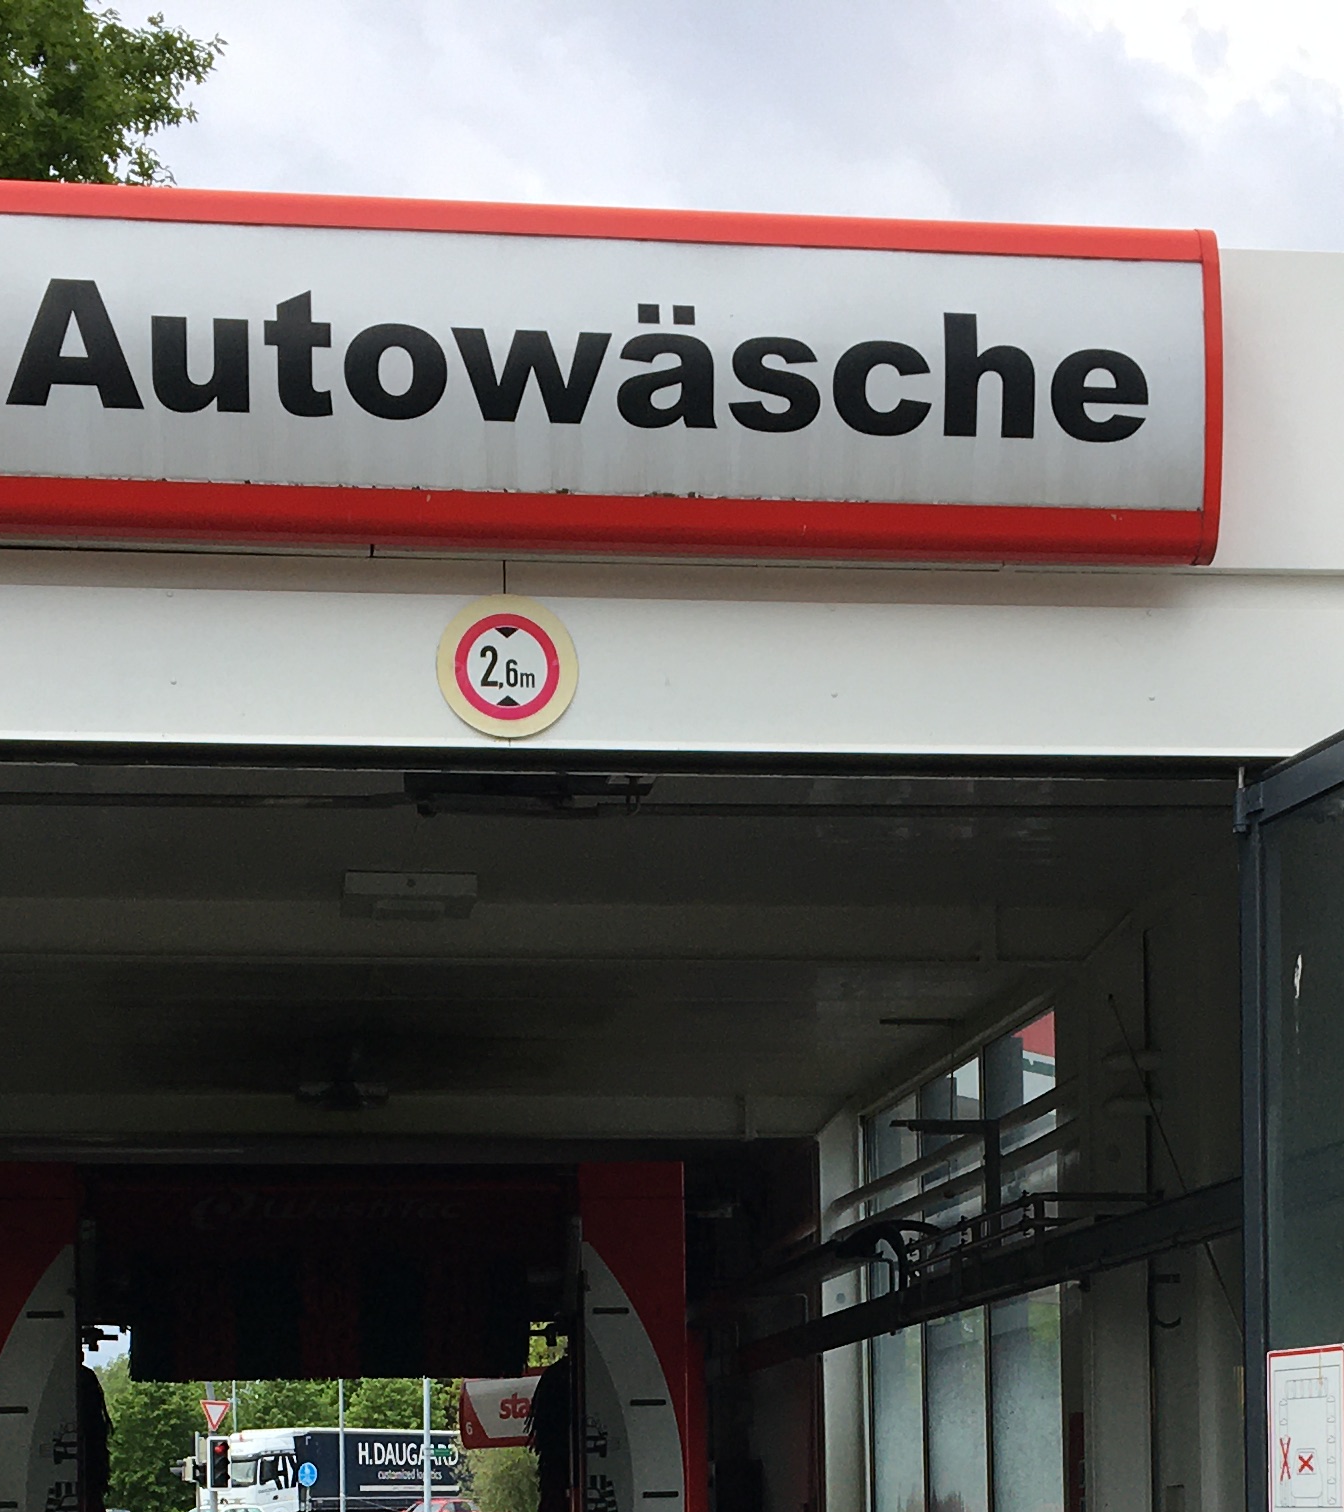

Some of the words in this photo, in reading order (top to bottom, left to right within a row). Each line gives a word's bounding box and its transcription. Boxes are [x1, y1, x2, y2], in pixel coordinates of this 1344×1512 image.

[6, 277, 1149, 443] Autowäsche
[479, 645, 536, 690] 2,6m
[499, 1392, 531, 1419] sta
[465, 1422, 473, 1435] 6
[378, 1469, 416, 1480] customized
